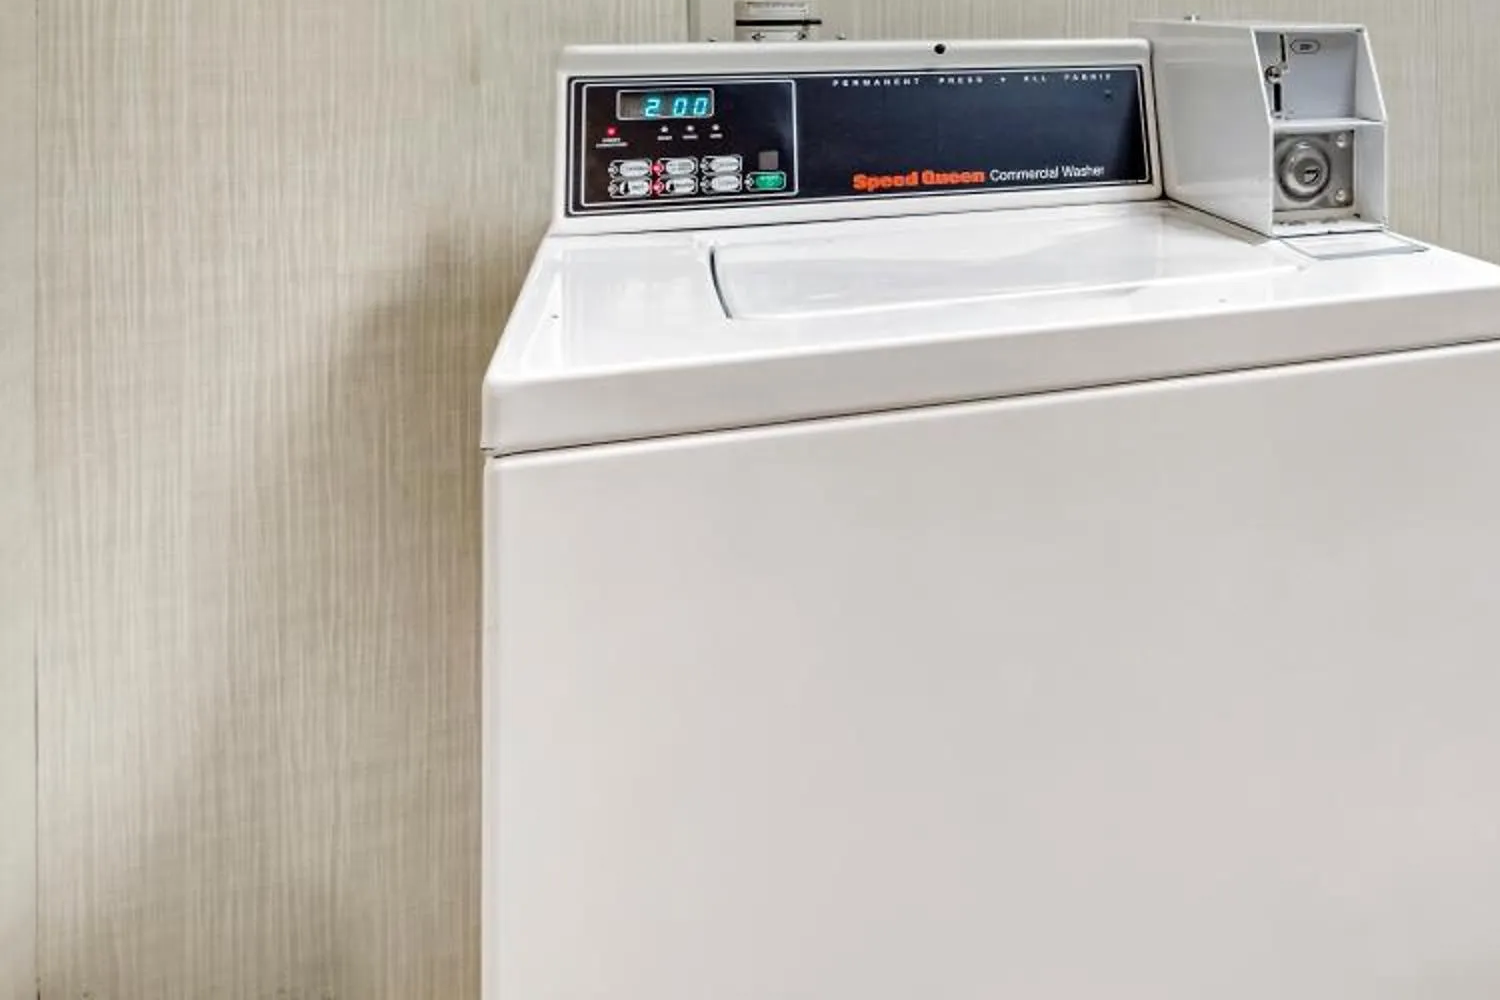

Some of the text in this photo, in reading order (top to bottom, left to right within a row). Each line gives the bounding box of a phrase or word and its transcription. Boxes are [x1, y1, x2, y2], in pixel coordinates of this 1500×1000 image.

[832, 77, 920, 87] PERMANENT
[853, 164, 1105, 193] Speed Queen Commercial Washer
